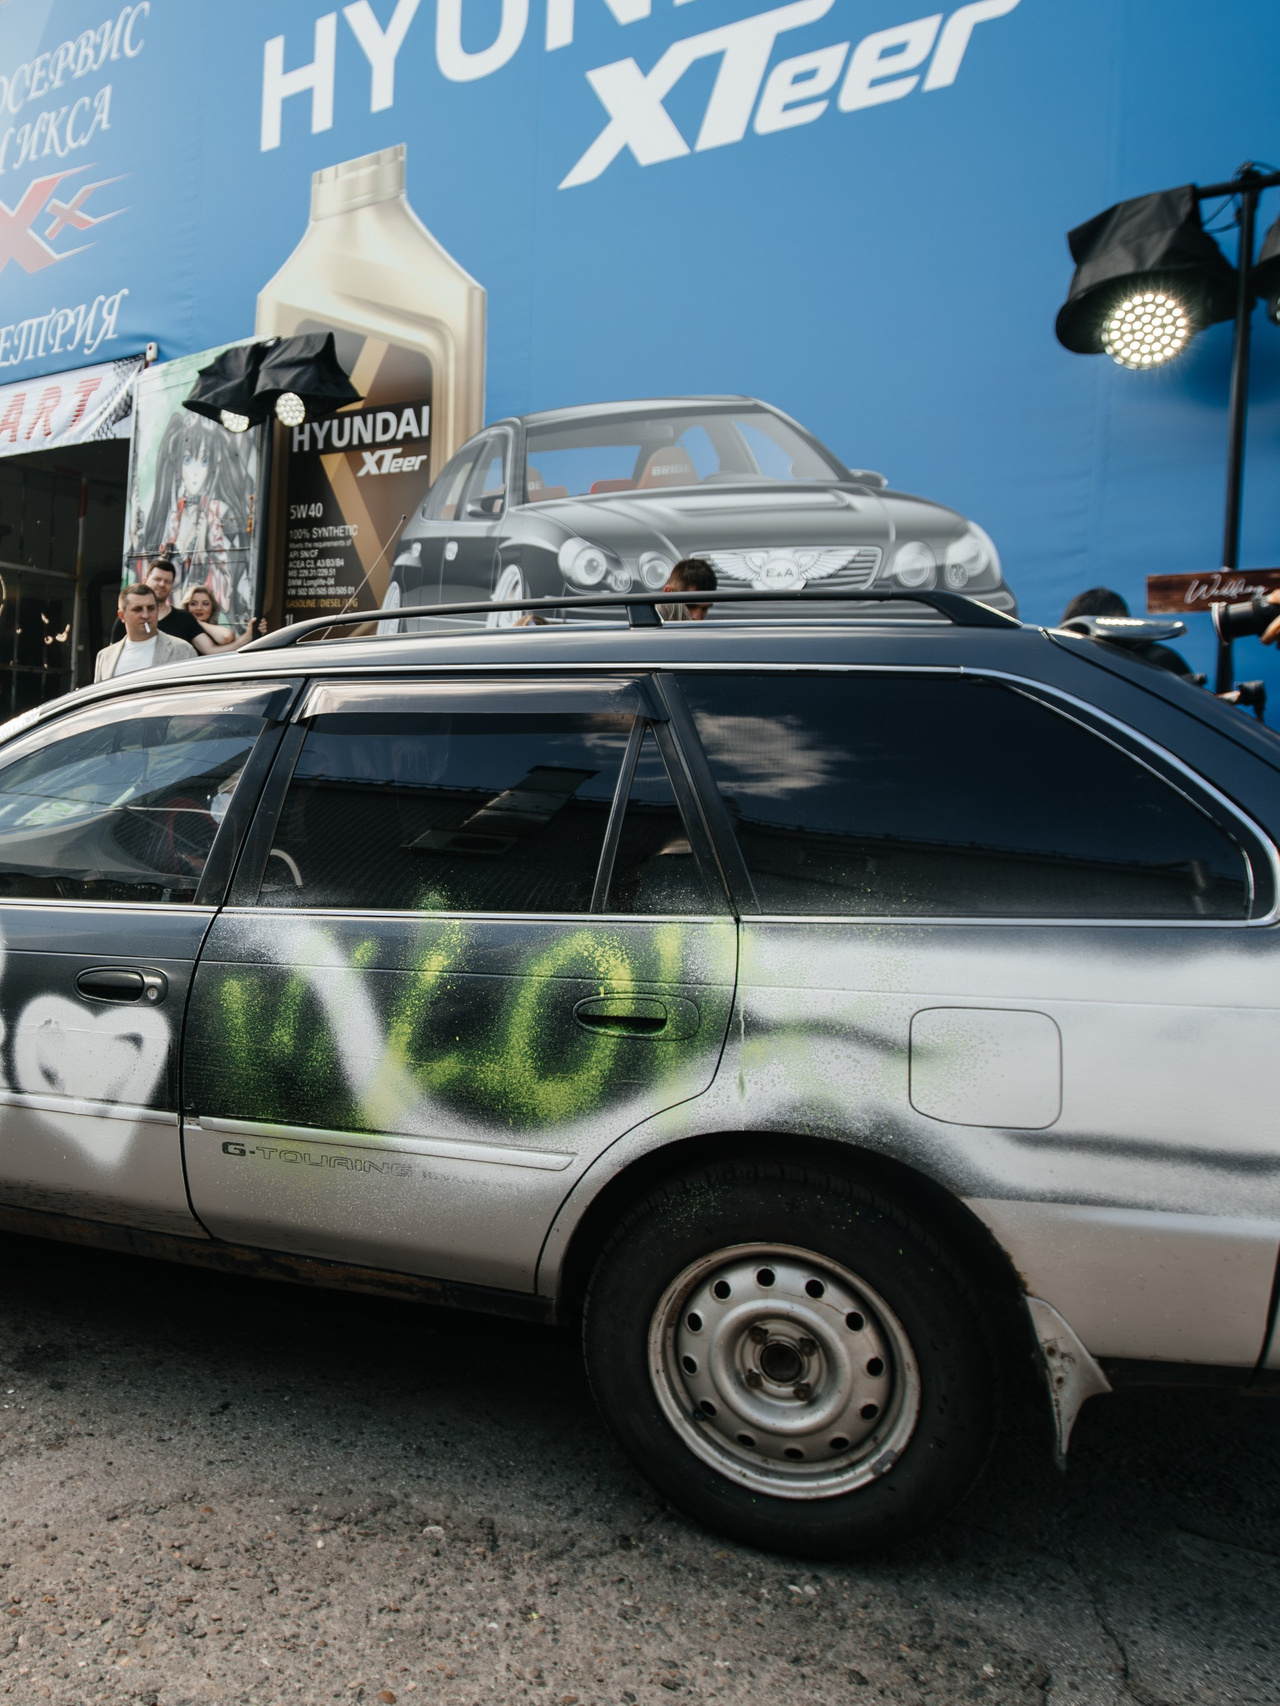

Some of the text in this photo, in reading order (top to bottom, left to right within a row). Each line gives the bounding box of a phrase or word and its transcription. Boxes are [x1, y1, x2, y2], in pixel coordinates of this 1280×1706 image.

[12, 84, 112, 171] ИКСА
[292, 406, 430, 452] HYUNDAI
[289, 502, 323, 519] 5W40
[312, 524, 358, 538] SYNTHETIC
[221, 1141, 414, 1178] G-TOURING
